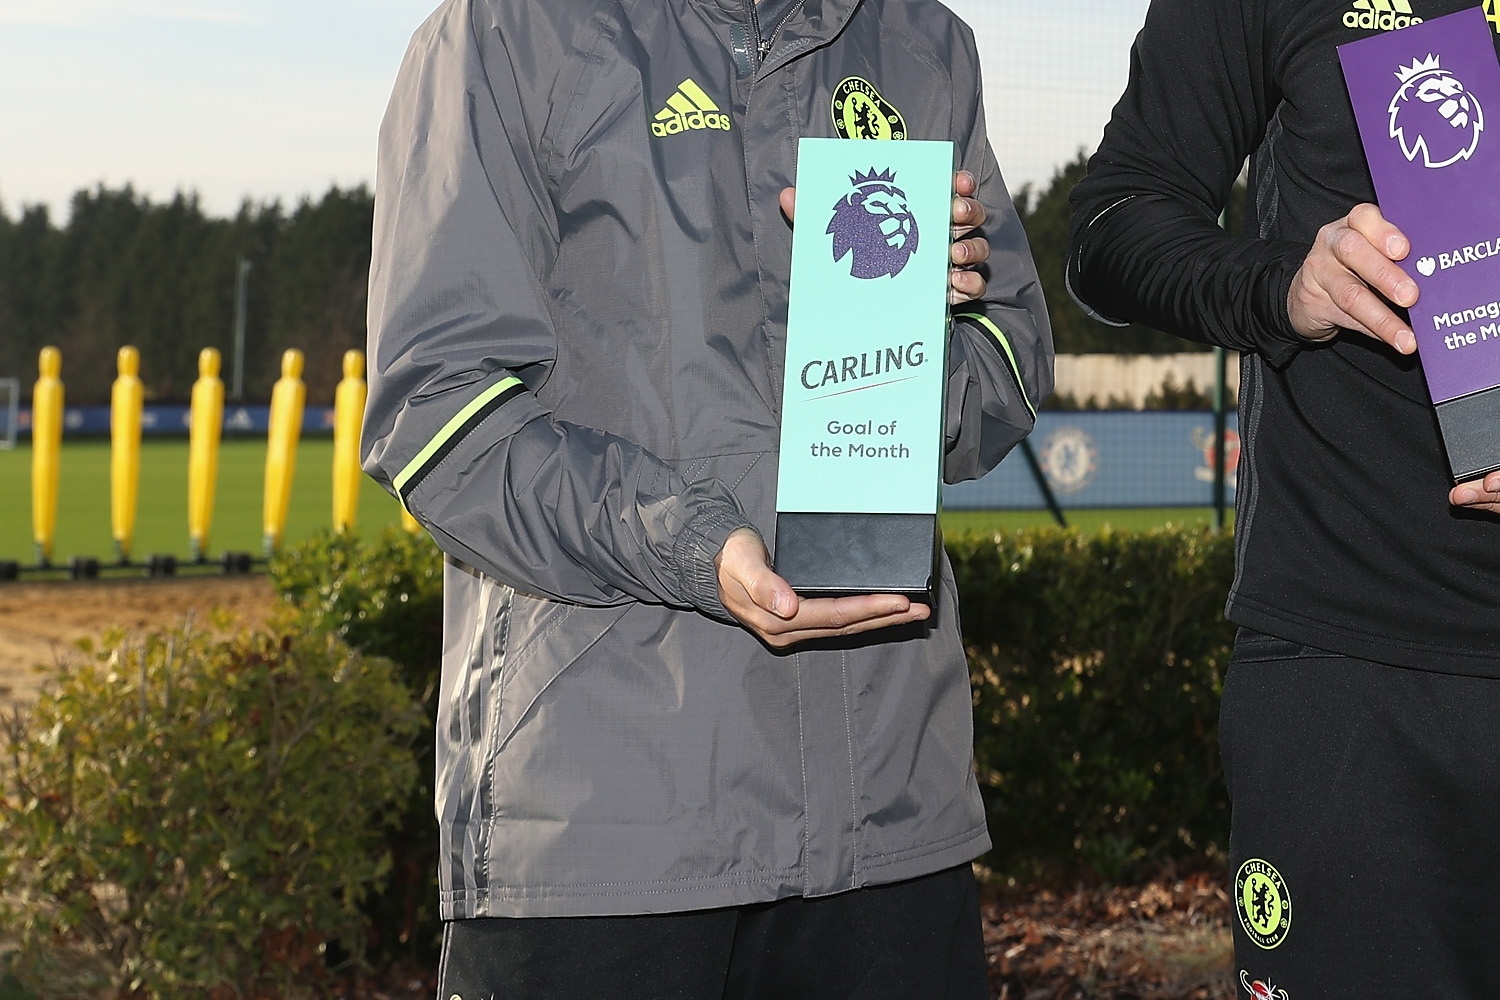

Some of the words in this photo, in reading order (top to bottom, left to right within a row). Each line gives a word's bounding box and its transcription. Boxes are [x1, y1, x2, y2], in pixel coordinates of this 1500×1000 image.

[842, 80, 881, 108] CHELSEA
[651, 109, 732, 137] adidas
[1444, 332, 1478, 351] the
[800, 341, 924, 390] CARLING
[827, 420, 872, 435] Goal
[877, 420, 897, 435] of
[810, 442, 843, 457] the
[848, 443, 910, 458] Month
[1244, 862, 1282, 889] CHELSEA
